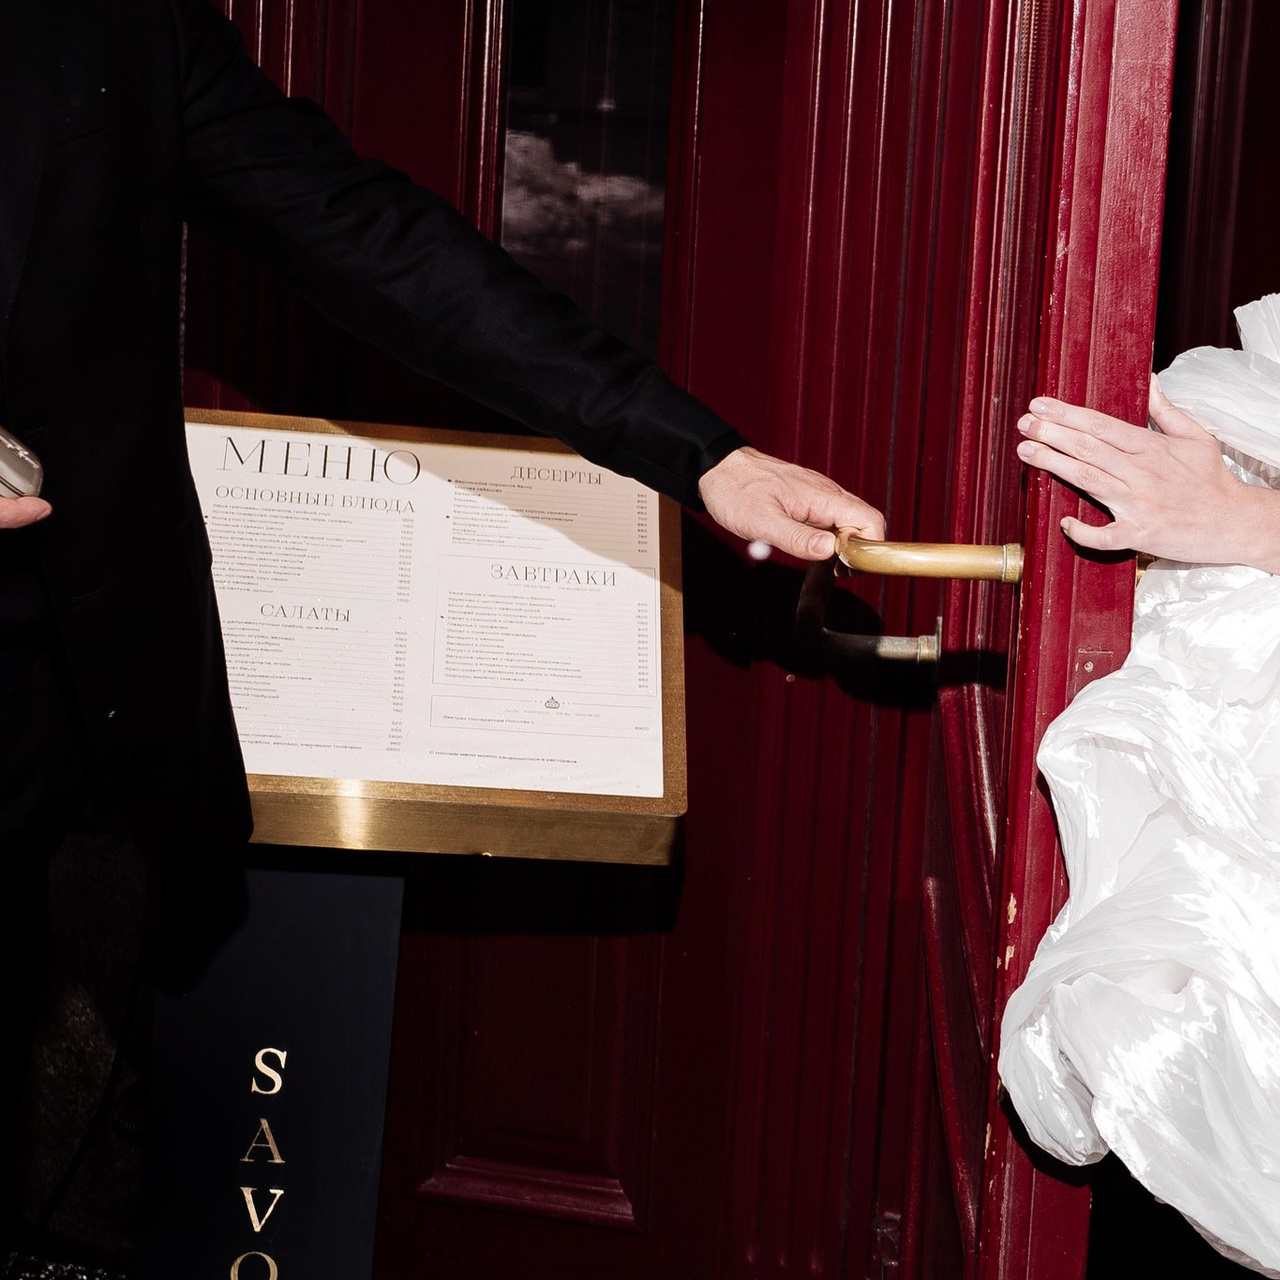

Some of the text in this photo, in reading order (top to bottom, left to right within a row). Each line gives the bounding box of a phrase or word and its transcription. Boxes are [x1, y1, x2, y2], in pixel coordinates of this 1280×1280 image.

[217, 435, 421, 485] МЕНЮ
[510, 465, 603, 486] ДЕСЕРТЫ
[215, 485, 415, 514] ОСНОВНЫЕ БЛЮДА
[490, 563, 618, 587] ЗАВТРАКИ
[260, 602, 351, 623] САЛАТЫ
